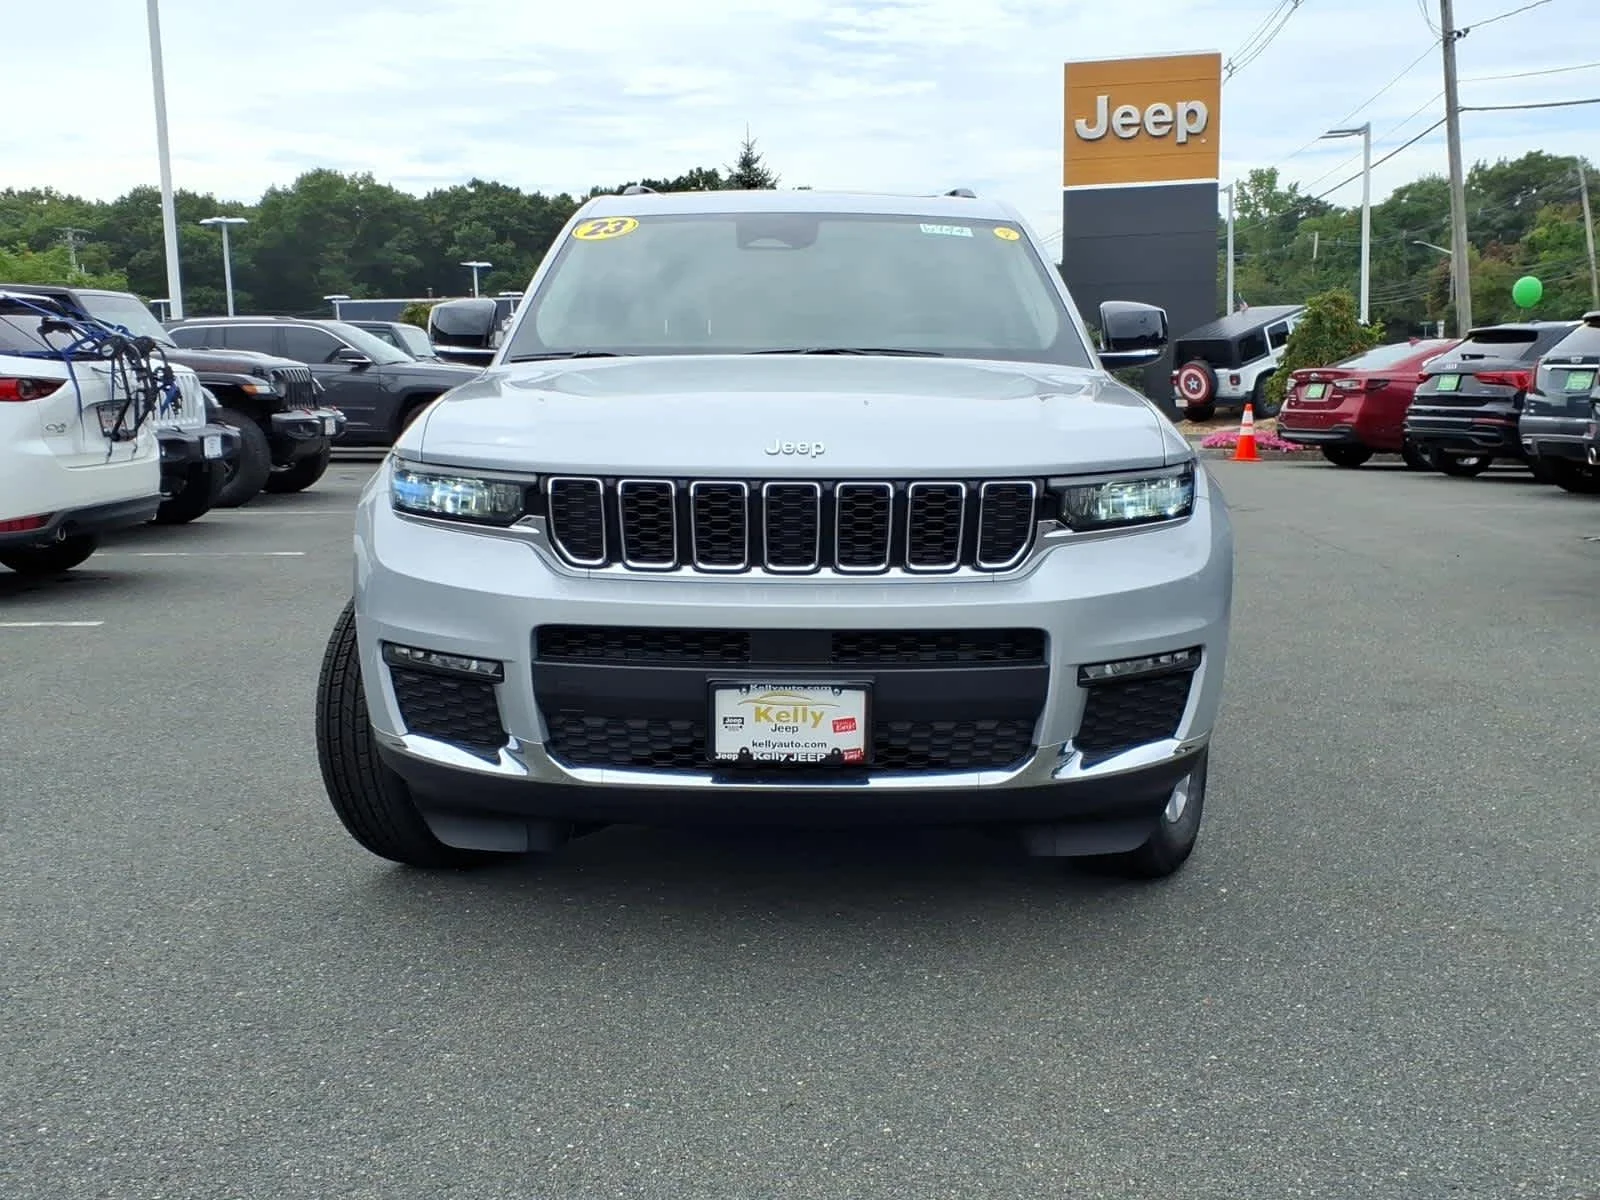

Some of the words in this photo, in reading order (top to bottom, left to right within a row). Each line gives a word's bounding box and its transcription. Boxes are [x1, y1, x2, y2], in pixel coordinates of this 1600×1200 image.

[1075, 95, 1208, 144] Jeep
[584, 220, 628, 236] 23
[765, 439, 825, 458] Jeep
[754, 706, 824, 728] Kelly
[770, 724, 799, 734] Jeep
[752, 740, 827, 749] kellyauto.com
[715, 752, 738, 761] Jeep
[753, 752, 787, 761] Kelly
[789, 753, 826, 762] JEEP
